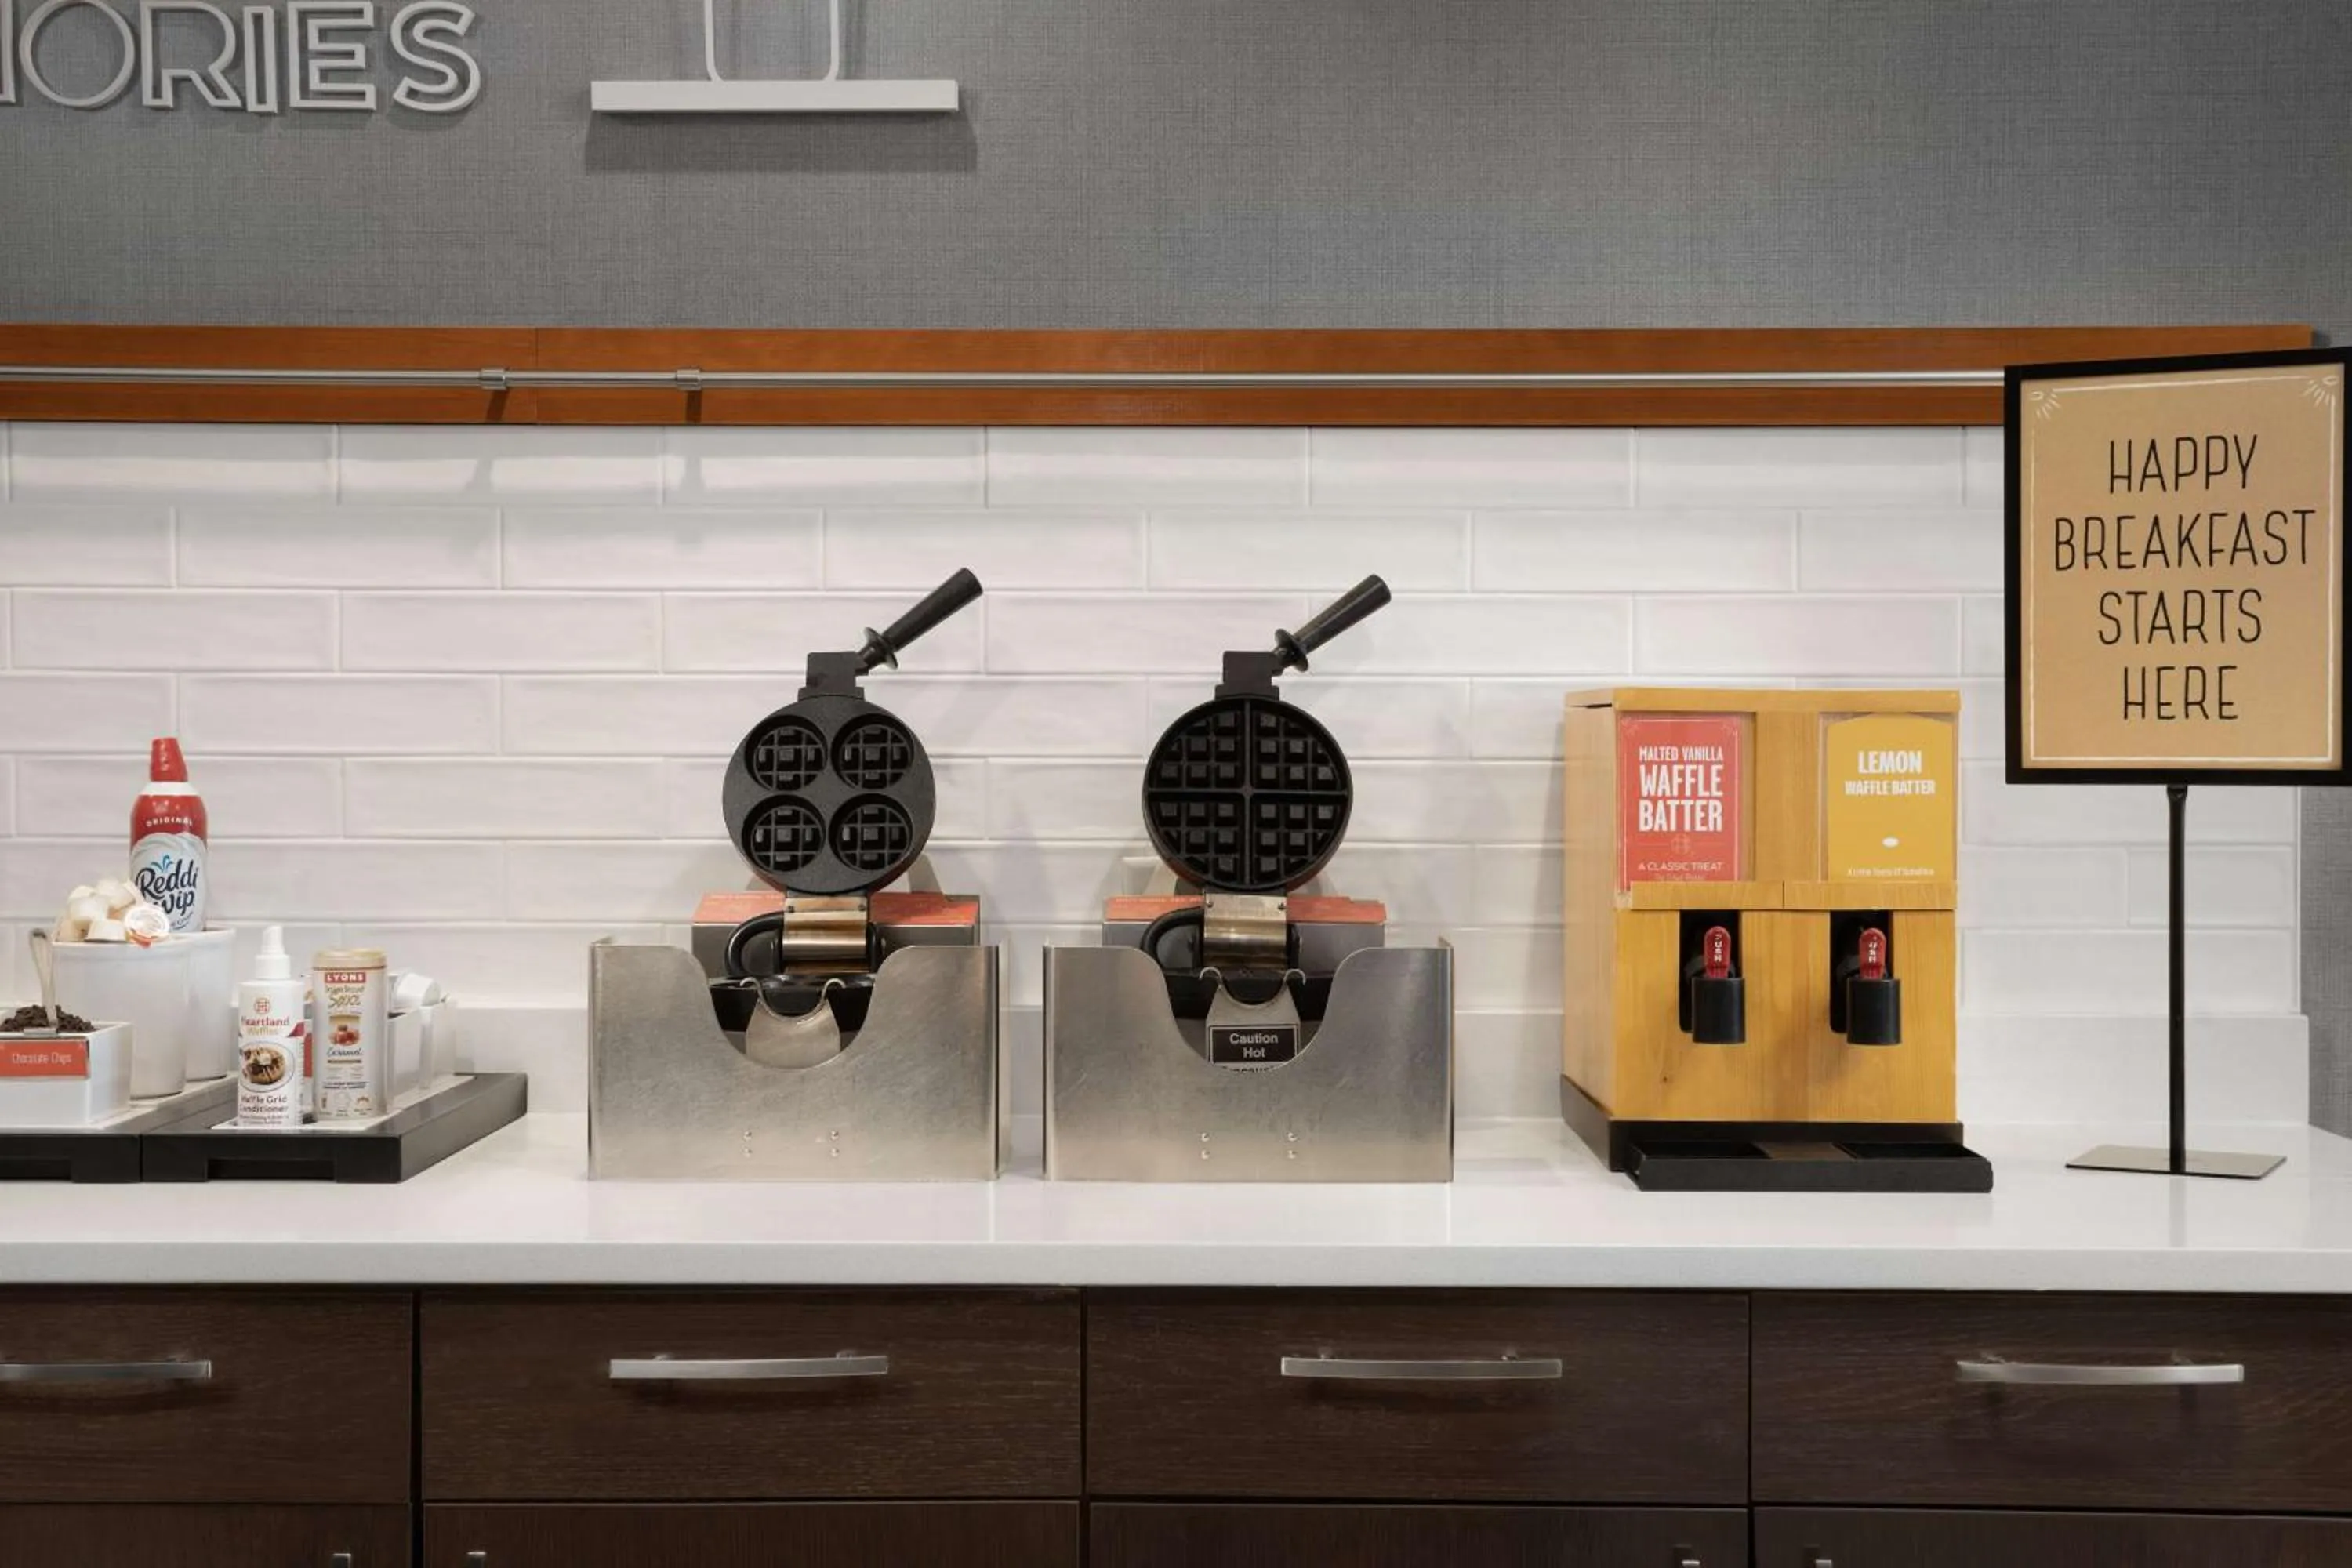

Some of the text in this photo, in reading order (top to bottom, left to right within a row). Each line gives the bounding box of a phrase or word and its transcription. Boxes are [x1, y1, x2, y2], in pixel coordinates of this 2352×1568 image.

[0, 0, 481, 112] ORIES
[2109, 434, 2258, 494] HAPPY
[2054, 510, 2316, 571] BREAKFAST
[2098, 588, 2263, 645] STARTS
[2123, 666, 2238, 720] HERE
[1639, 746, 1723, 761] MALTED VANILLA
[1858, 750, 1922, 775] LEMON
[1639, 764, 1724, 797] WAFFLE
[1845, 780, 1935, 796] WAFFLE BATTER
[1639, 800, 1723, 832] BATTER
[136, 859, 198, 900] Reddi
[1648, 862, 1689, 871] CLASSIC
[1691, 862, 1723, 871] TREAT
[327, 973, 364, 982] LYONS
[1229, 1033, 1279, 1044] Caution
[1243, 1047, 1265, 1058] Hot
